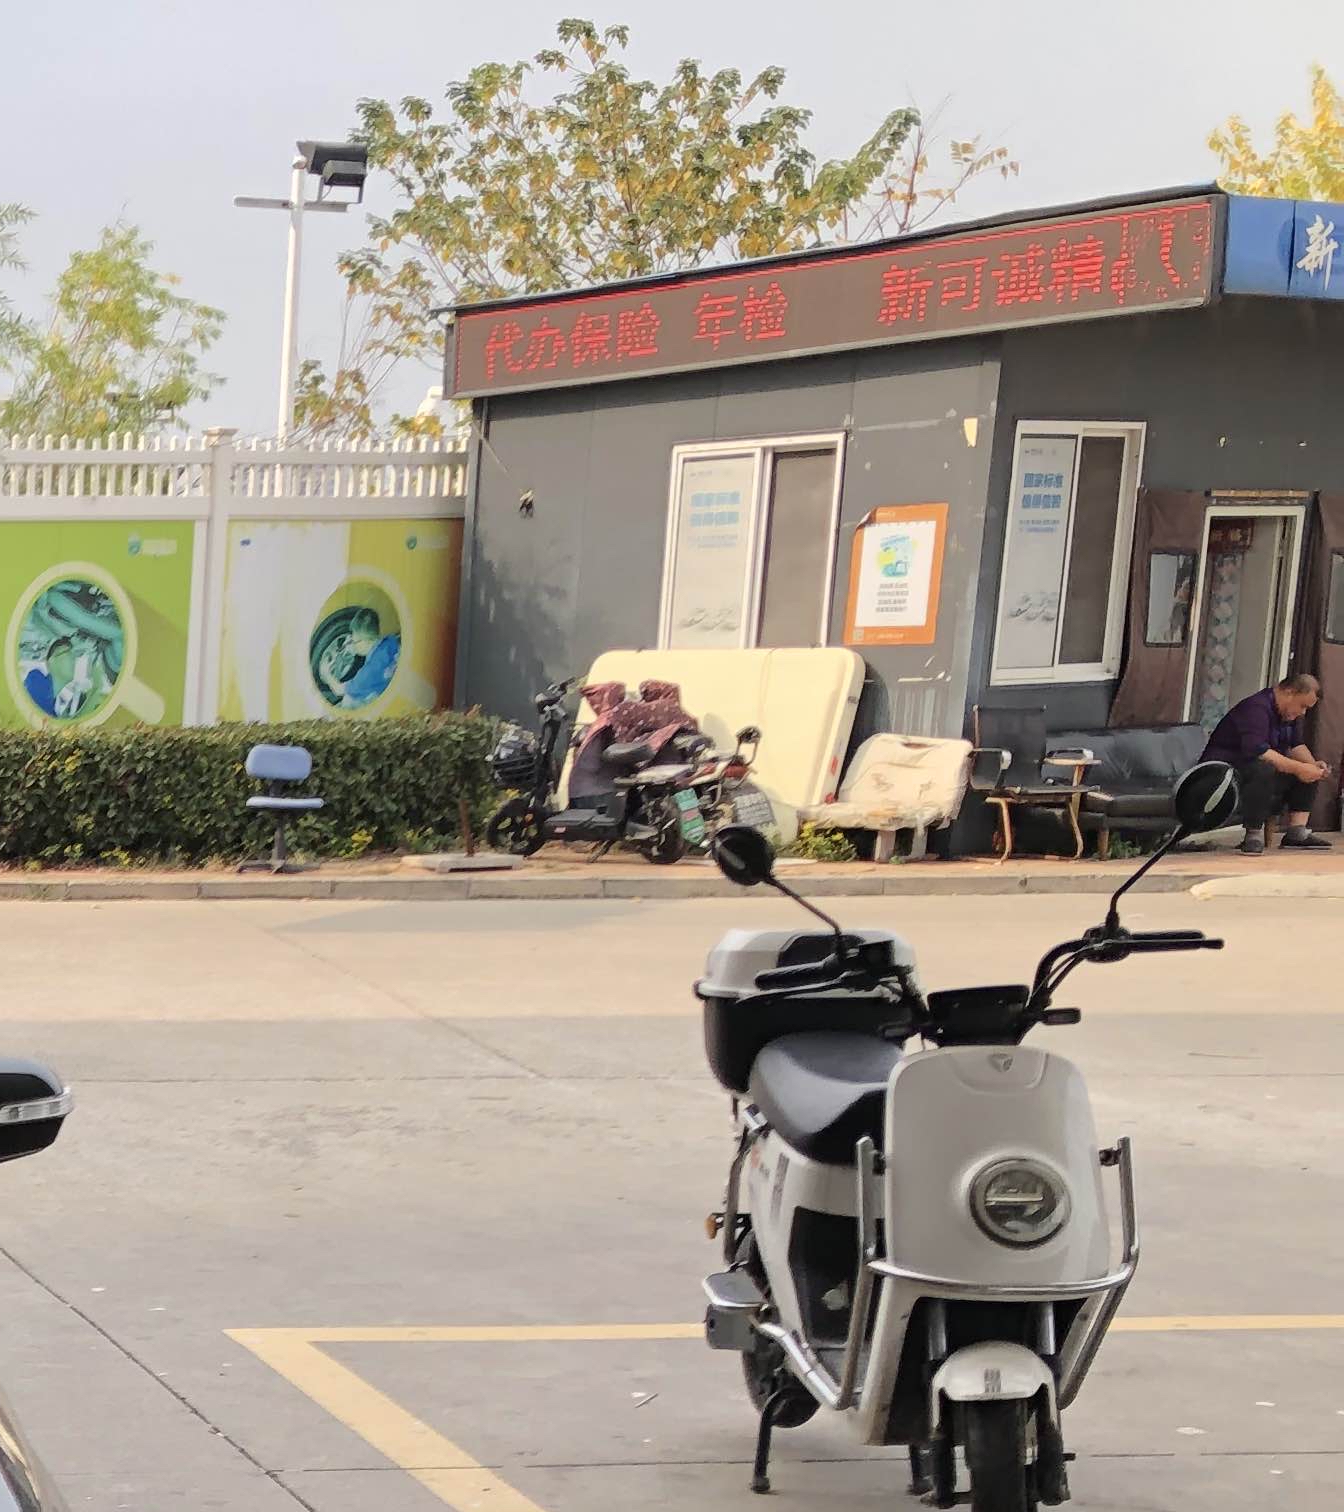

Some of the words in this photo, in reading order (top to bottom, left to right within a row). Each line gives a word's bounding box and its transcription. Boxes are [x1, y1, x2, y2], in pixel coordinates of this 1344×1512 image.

[485, 301, 661, 380] 代办保险
[692, 281, 789, 351] 年检
